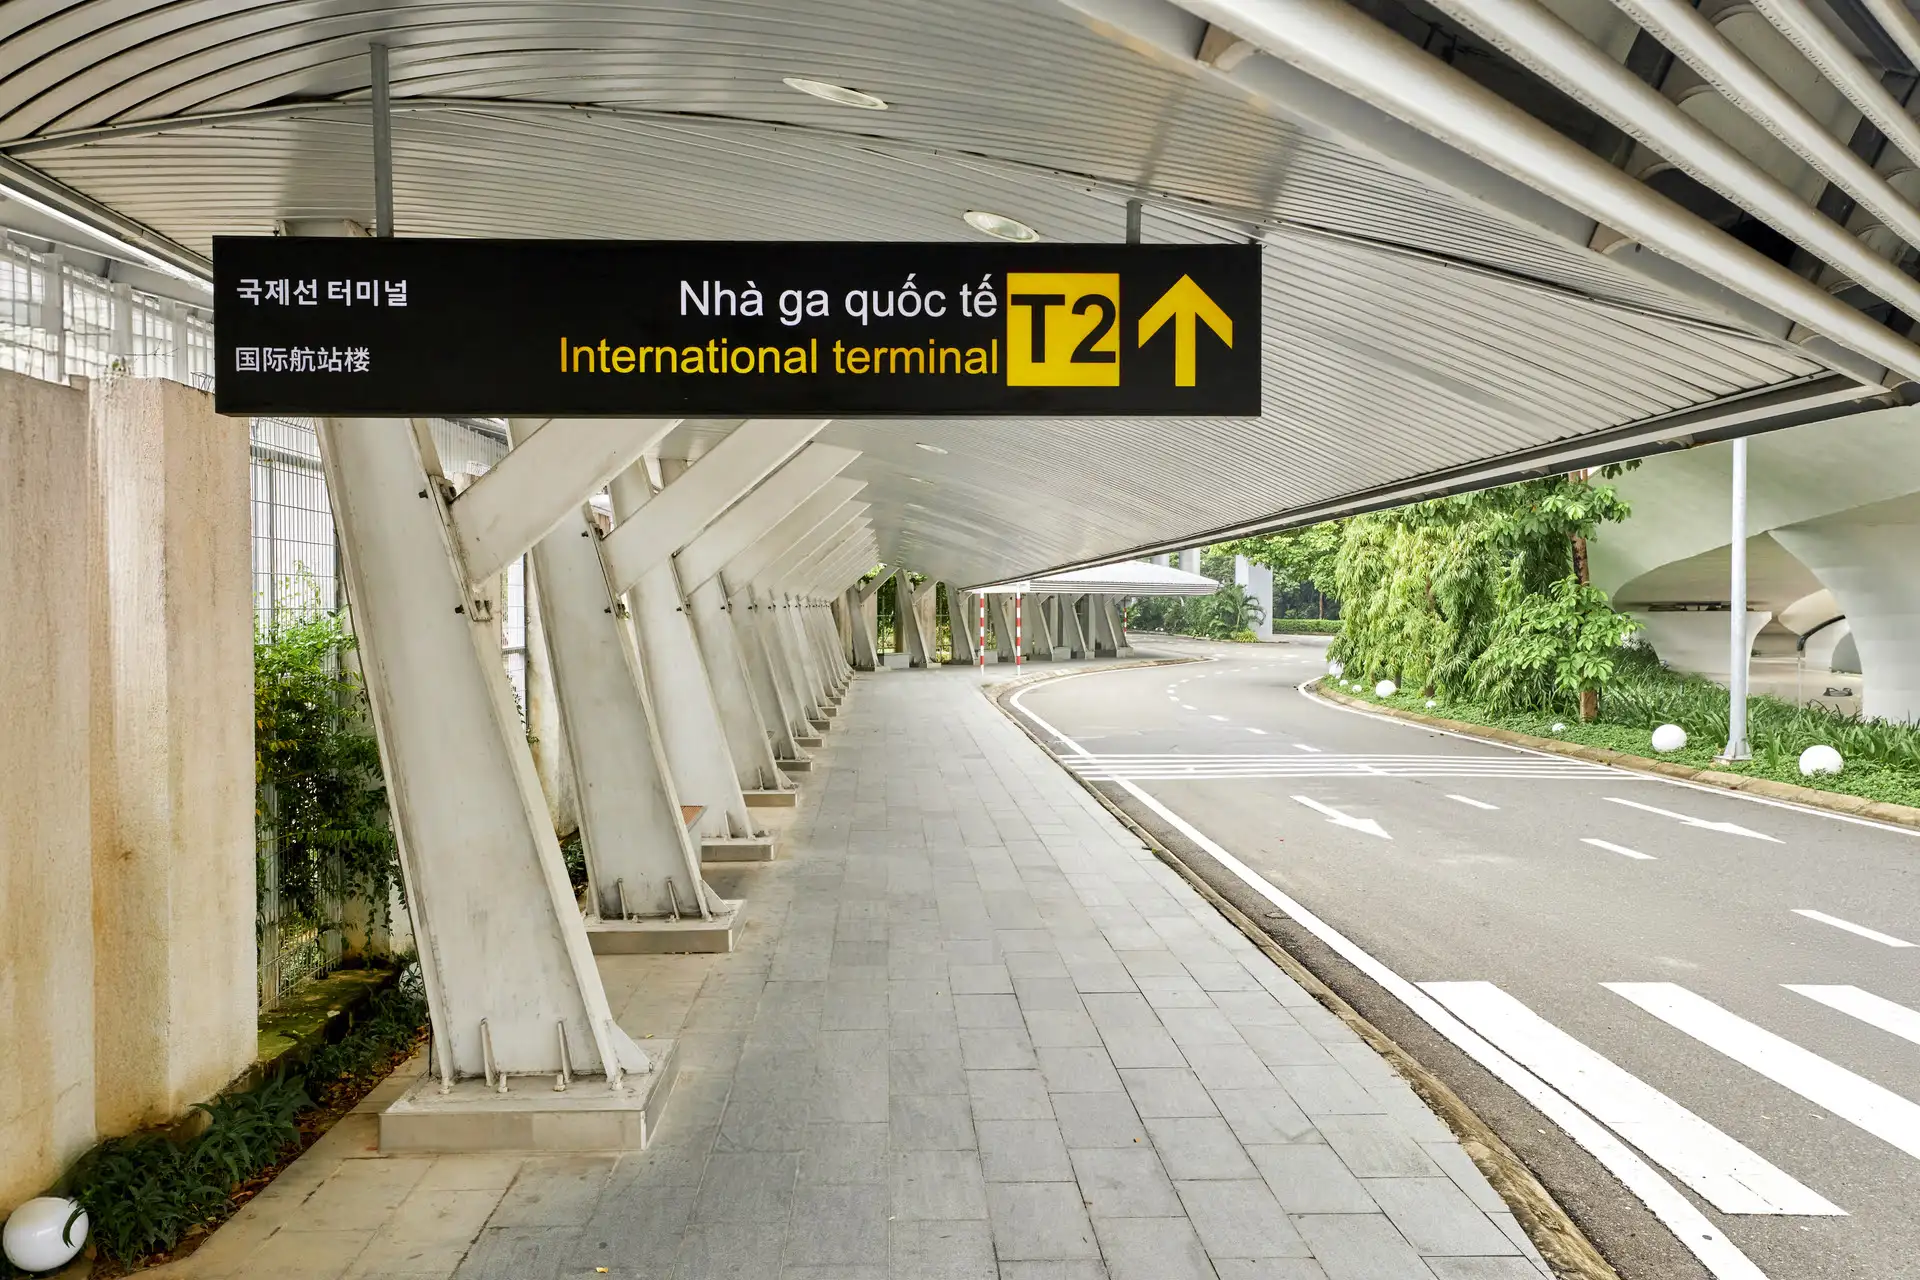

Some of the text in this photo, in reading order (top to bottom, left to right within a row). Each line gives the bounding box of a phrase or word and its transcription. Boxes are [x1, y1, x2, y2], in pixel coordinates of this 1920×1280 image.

[237, 279, 407, 306] 국제선 터미널
[681, 273, 997, 326] Nhà ga quốc tế
[1011, 294, 1115, 363] T2
[236, 347, 369, 372] 国际航站楼
[561, 337, 997, 374] International terminal
